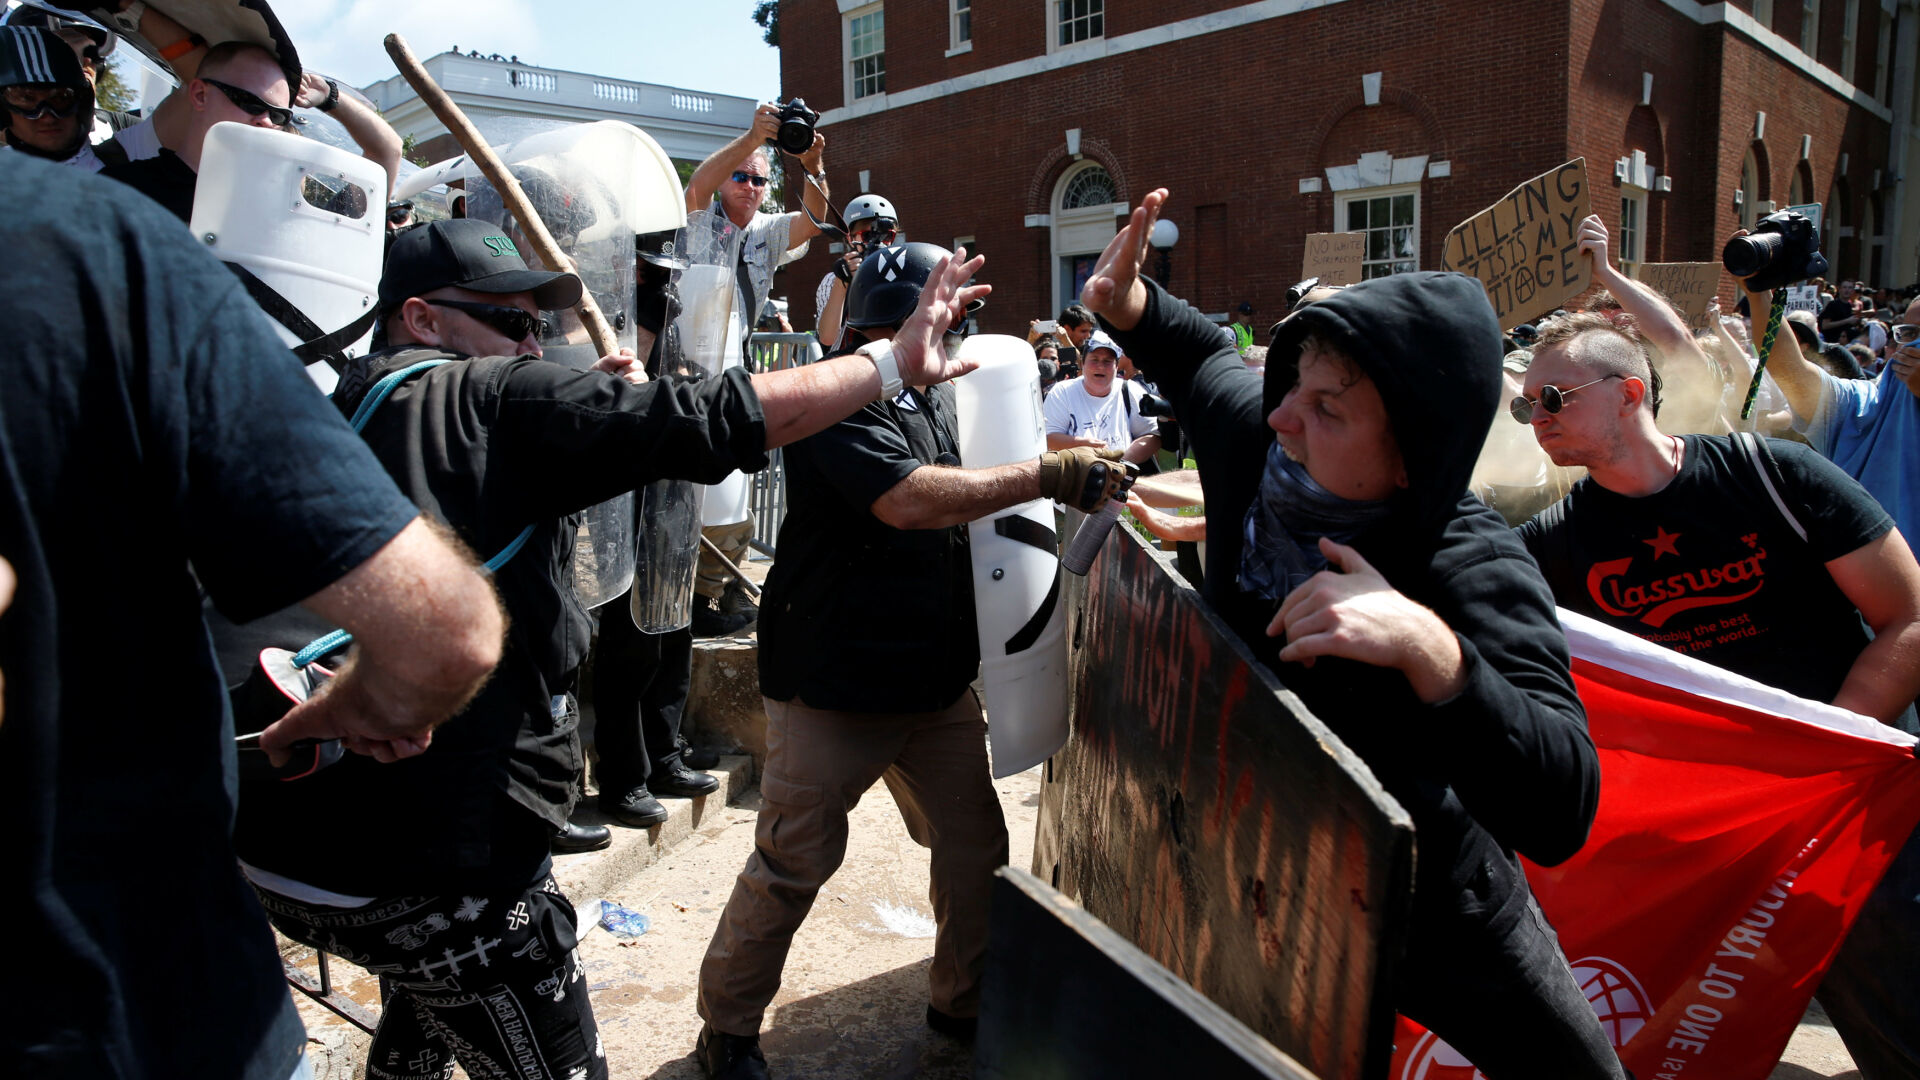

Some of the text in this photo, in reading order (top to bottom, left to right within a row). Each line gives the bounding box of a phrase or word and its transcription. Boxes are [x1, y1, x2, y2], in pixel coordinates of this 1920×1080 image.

[1536, 206, 1578, 256] MY
[1310, 240, 1361, 256] NO WHITE
[1320, 269, 1345, 281] HATE
[1488, 242, 1579, 318] ITAGE
[1787, 300, 1815, 311] PARKING
[1587, 547, 1766, 616] Classwar
[1694, 622, 1717, 636] the
[1719, 613, 1751, 629] best
[1674, 644, 1688, 653] in
[1690, 640, 1713, 652] the
